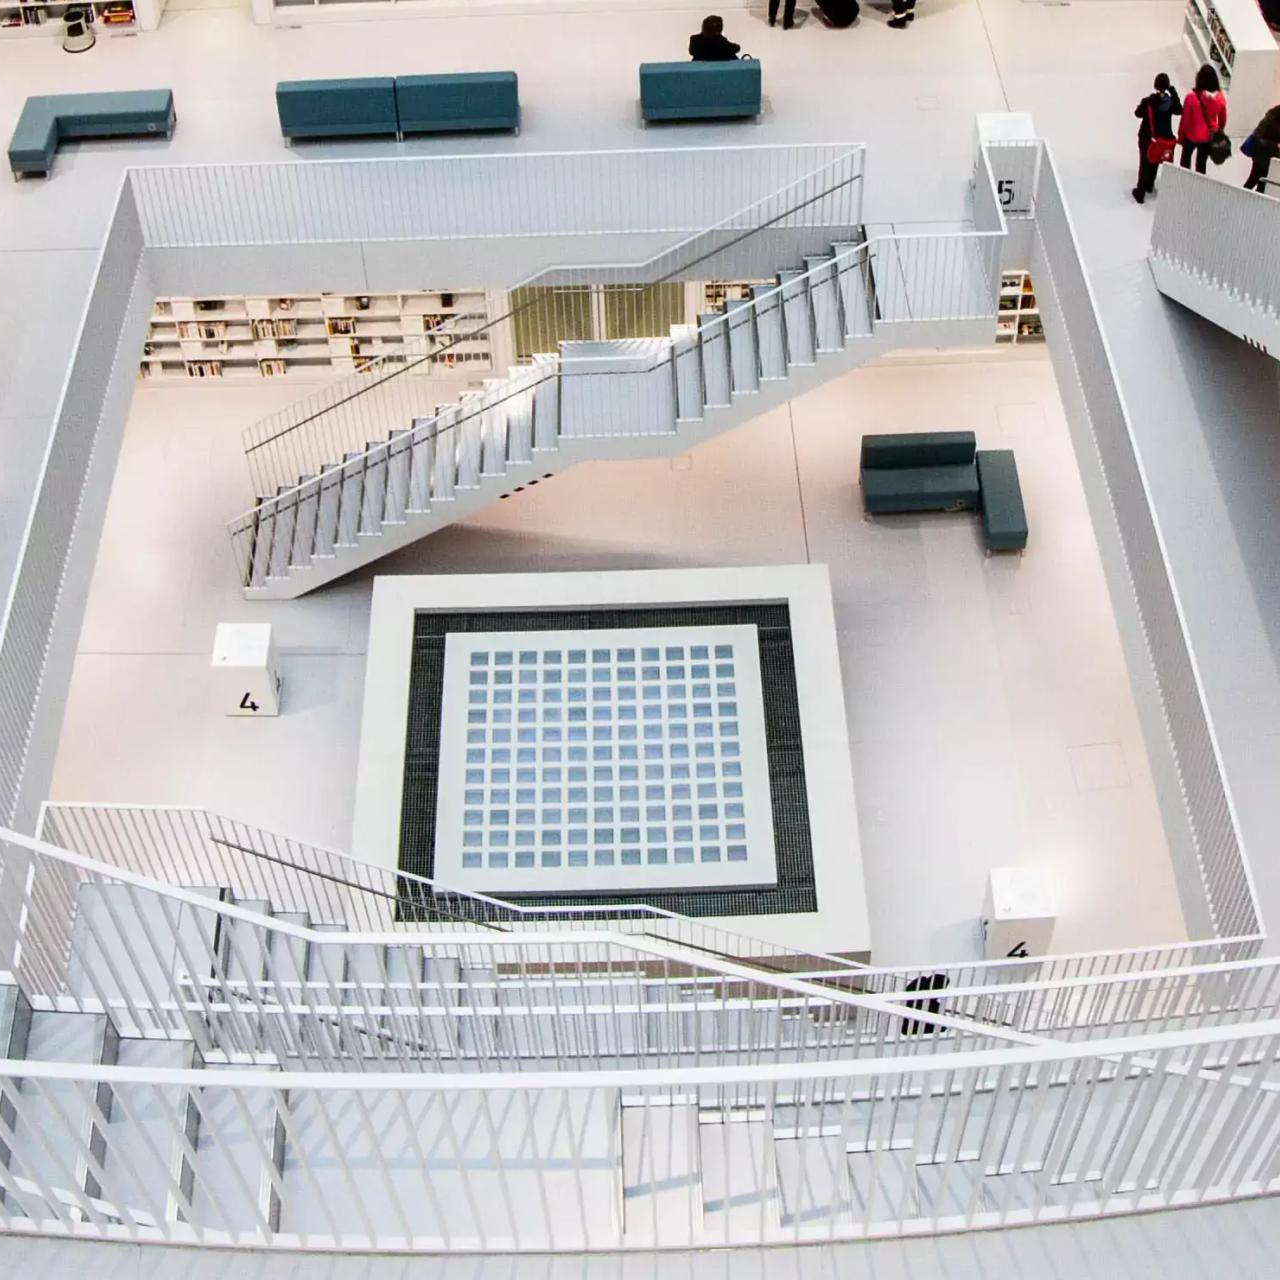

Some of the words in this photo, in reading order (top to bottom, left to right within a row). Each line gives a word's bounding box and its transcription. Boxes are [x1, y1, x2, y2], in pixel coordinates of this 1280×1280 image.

[997, 179, 1015, 205] 5
[239, 691, 260, 712] 4
[1006, 941, 1029, 958] 4
